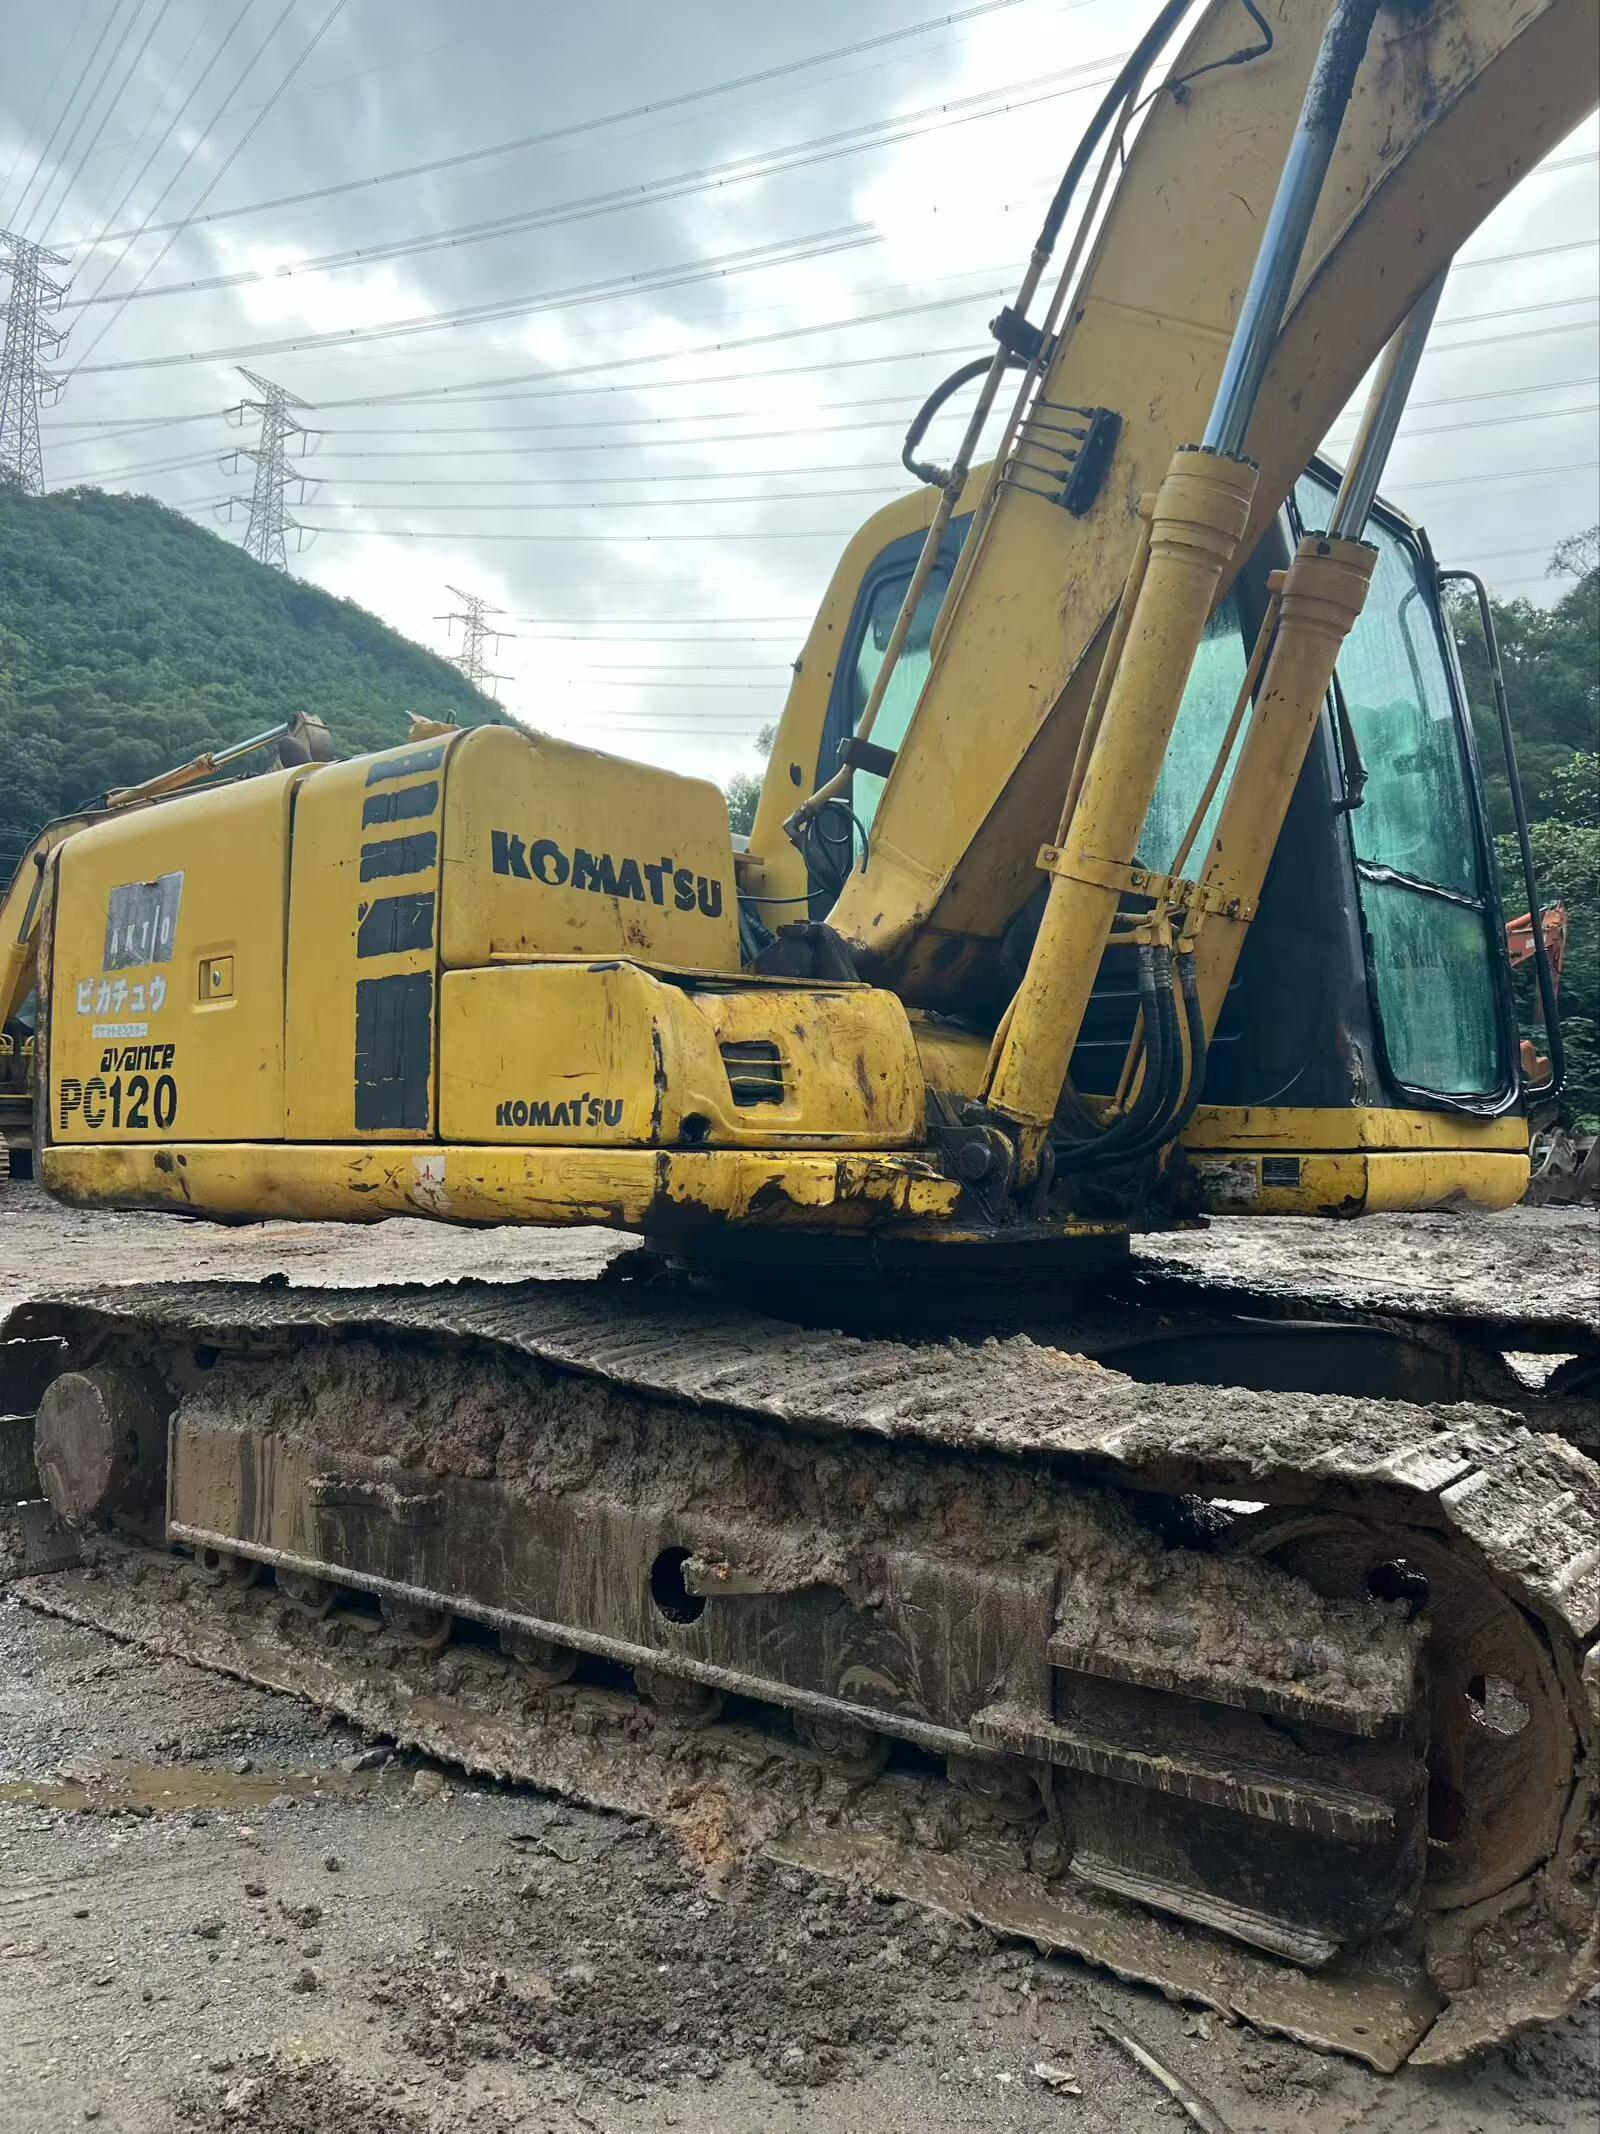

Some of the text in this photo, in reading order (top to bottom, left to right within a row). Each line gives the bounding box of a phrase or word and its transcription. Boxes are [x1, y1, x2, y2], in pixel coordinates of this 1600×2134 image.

[491, 830, 723, 918] KOMATSU
[111, 905, 171, 963] AKTIO
[60, 1074, 177, 1129] PC120
[496, 1092, 624, 1126] KOMATSU
